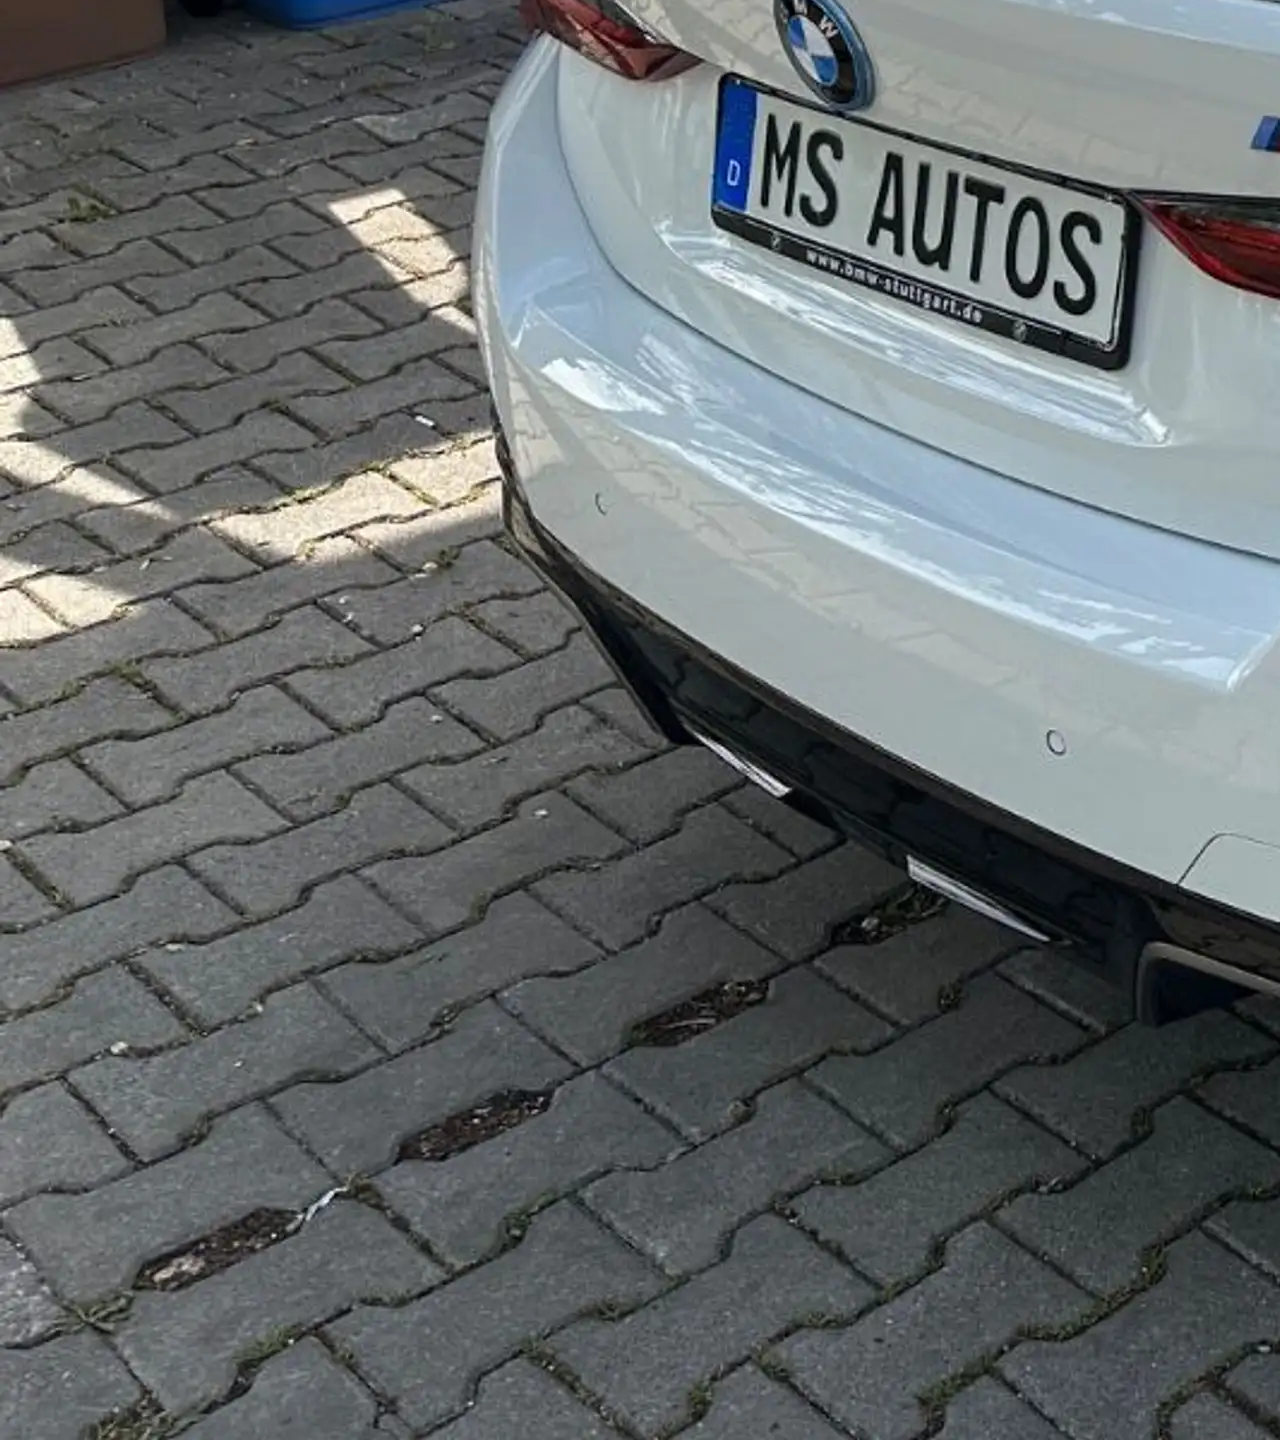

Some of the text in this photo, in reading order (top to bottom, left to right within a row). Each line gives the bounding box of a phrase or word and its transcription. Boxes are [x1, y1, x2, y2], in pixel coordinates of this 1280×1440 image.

[726, 160, 742, 187] D
[759, 113, 1103, 317] MS AUTOS
[805, 247, 984, 324] www.bmw-stuttgart.de
